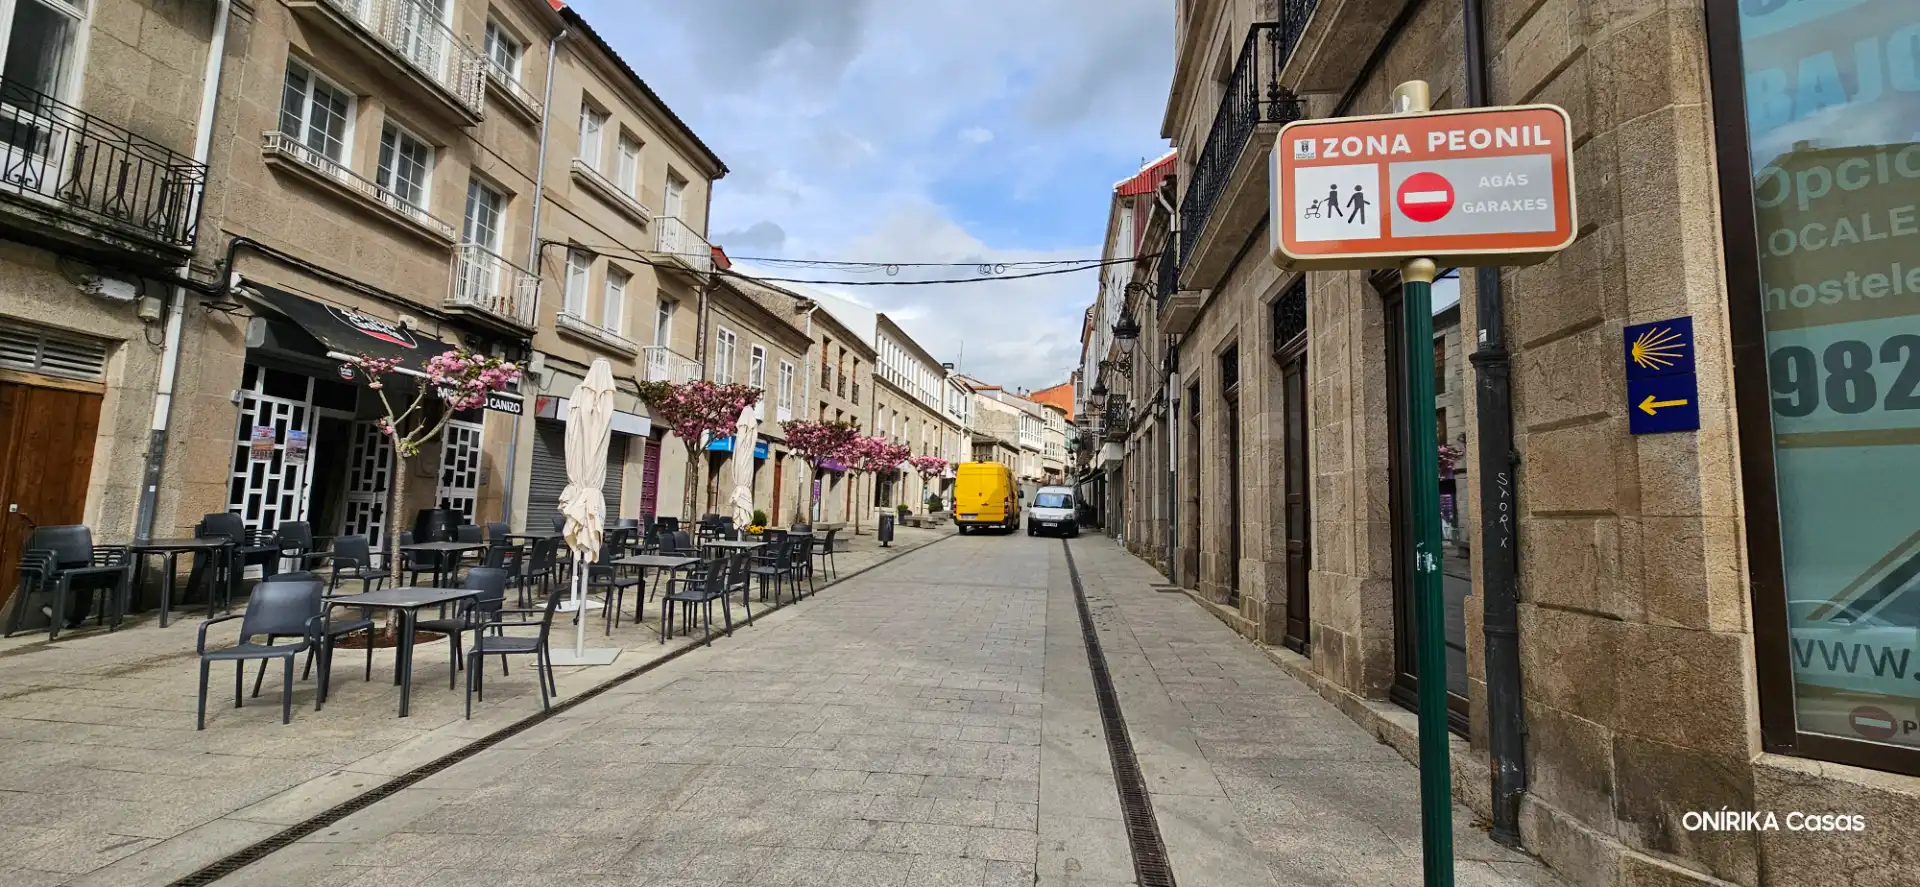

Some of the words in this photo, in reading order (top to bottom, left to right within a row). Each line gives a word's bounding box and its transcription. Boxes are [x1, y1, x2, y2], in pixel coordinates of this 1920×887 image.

[1322, 134, 1411, 159] ZONA
[1428, 125, 1551, 152] PEONIL
[1478, 172, 1529, 188] AGÁS
[1462, 198, 1548, 214] GARAXES
[1761, 205, 1919, 259] OCALE
[1769, 334, 1920, 417] 982
